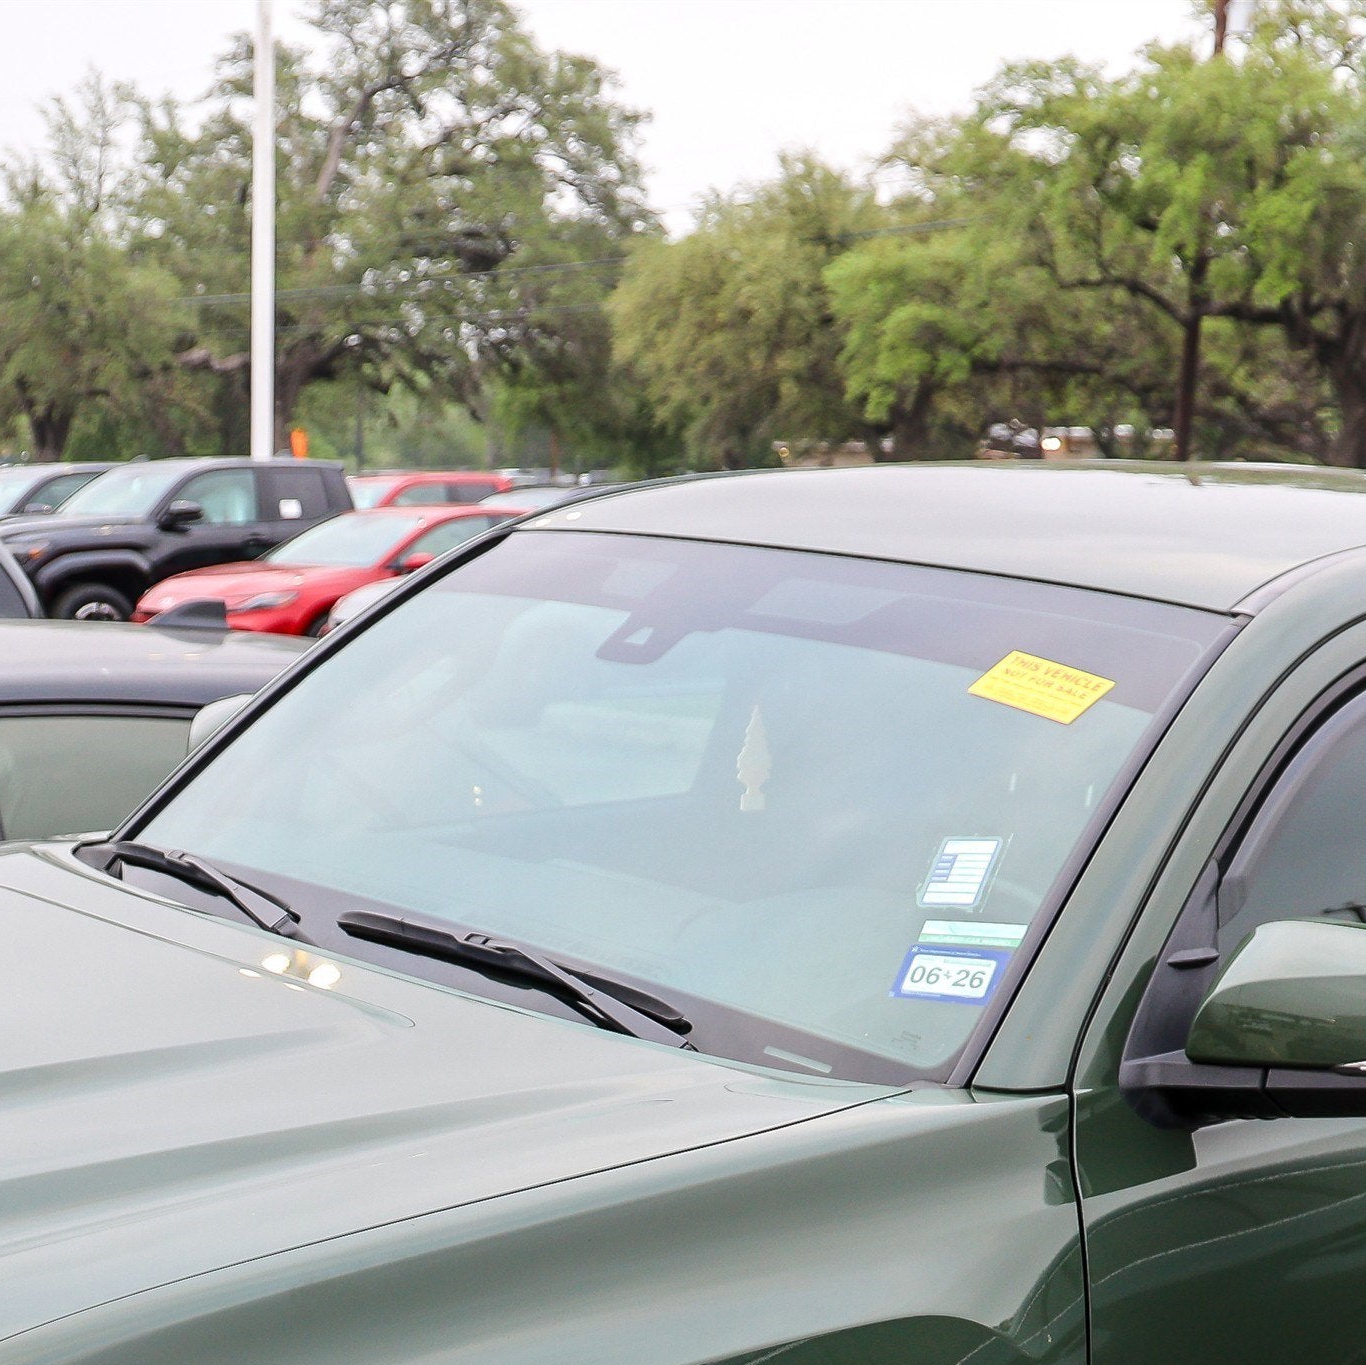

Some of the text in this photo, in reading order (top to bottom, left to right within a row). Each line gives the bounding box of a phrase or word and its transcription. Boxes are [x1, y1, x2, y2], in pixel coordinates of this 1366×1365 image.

[1002, 666, 1088, 700] NOT FOR SALE
[1011, 655, 1105, 692] THIS VEHICLE
